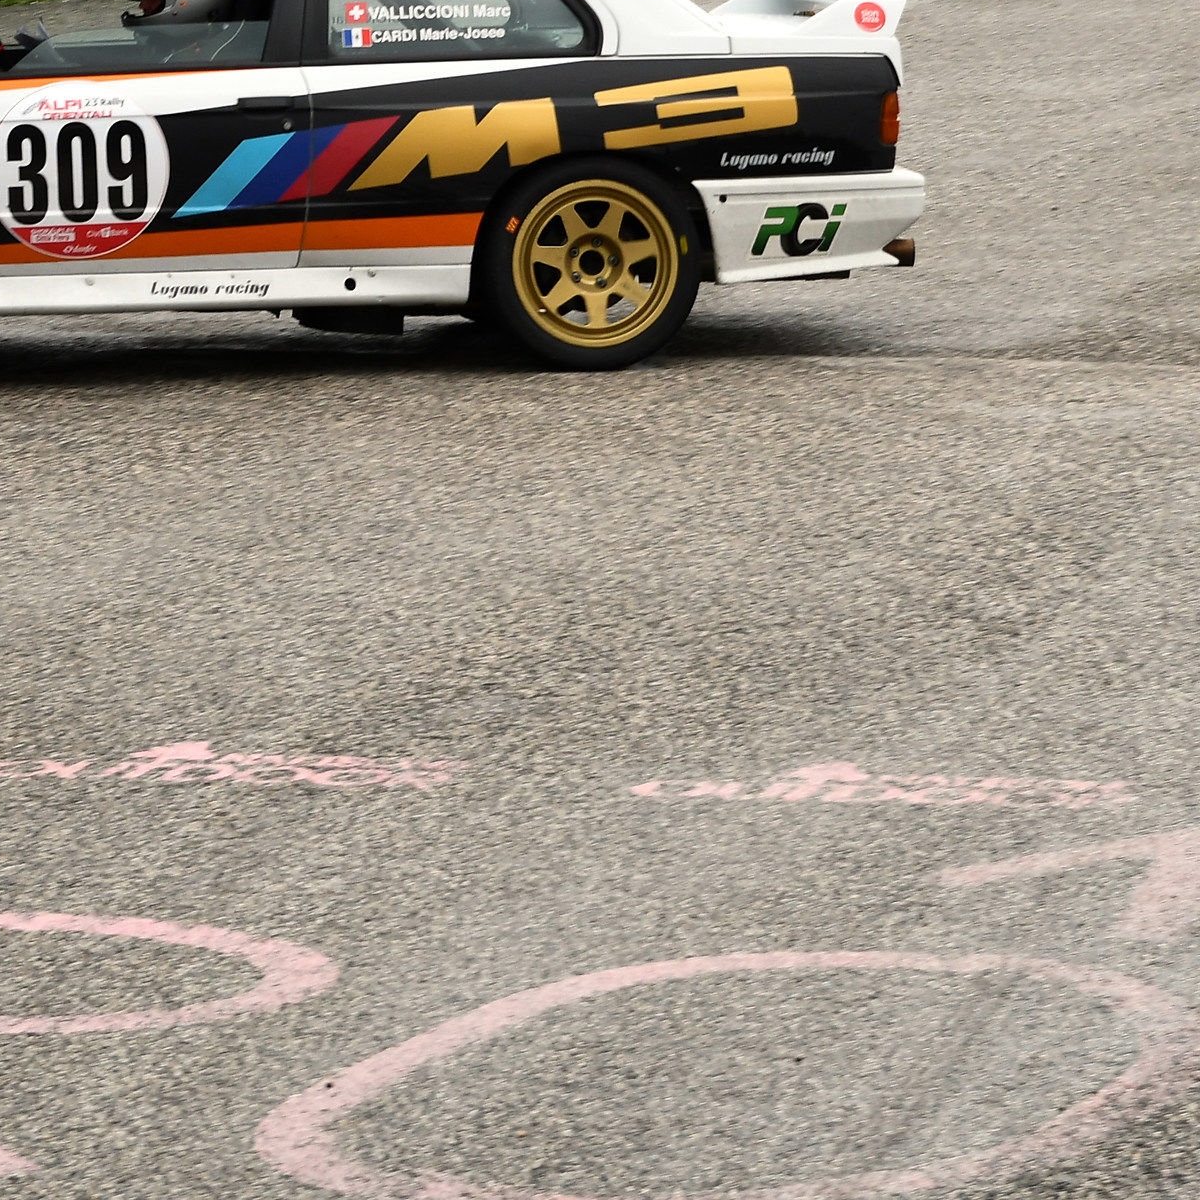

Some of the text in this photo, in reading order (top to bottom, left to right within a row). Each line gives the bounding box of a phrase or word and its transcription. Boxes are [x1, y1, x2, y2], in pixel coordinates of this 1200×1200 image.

[368, 4, 469, 20] VALLICCIONI
[473, 3, 511, 18] Marc
[370, 28, 417, 44] CARDI
[38, 98, 83, 112] ALPI
[720, 146, 836, 171] Lugano racing
[6, 119, 149, 225] 309
[150, 279, 271, 299] Lugano racing
